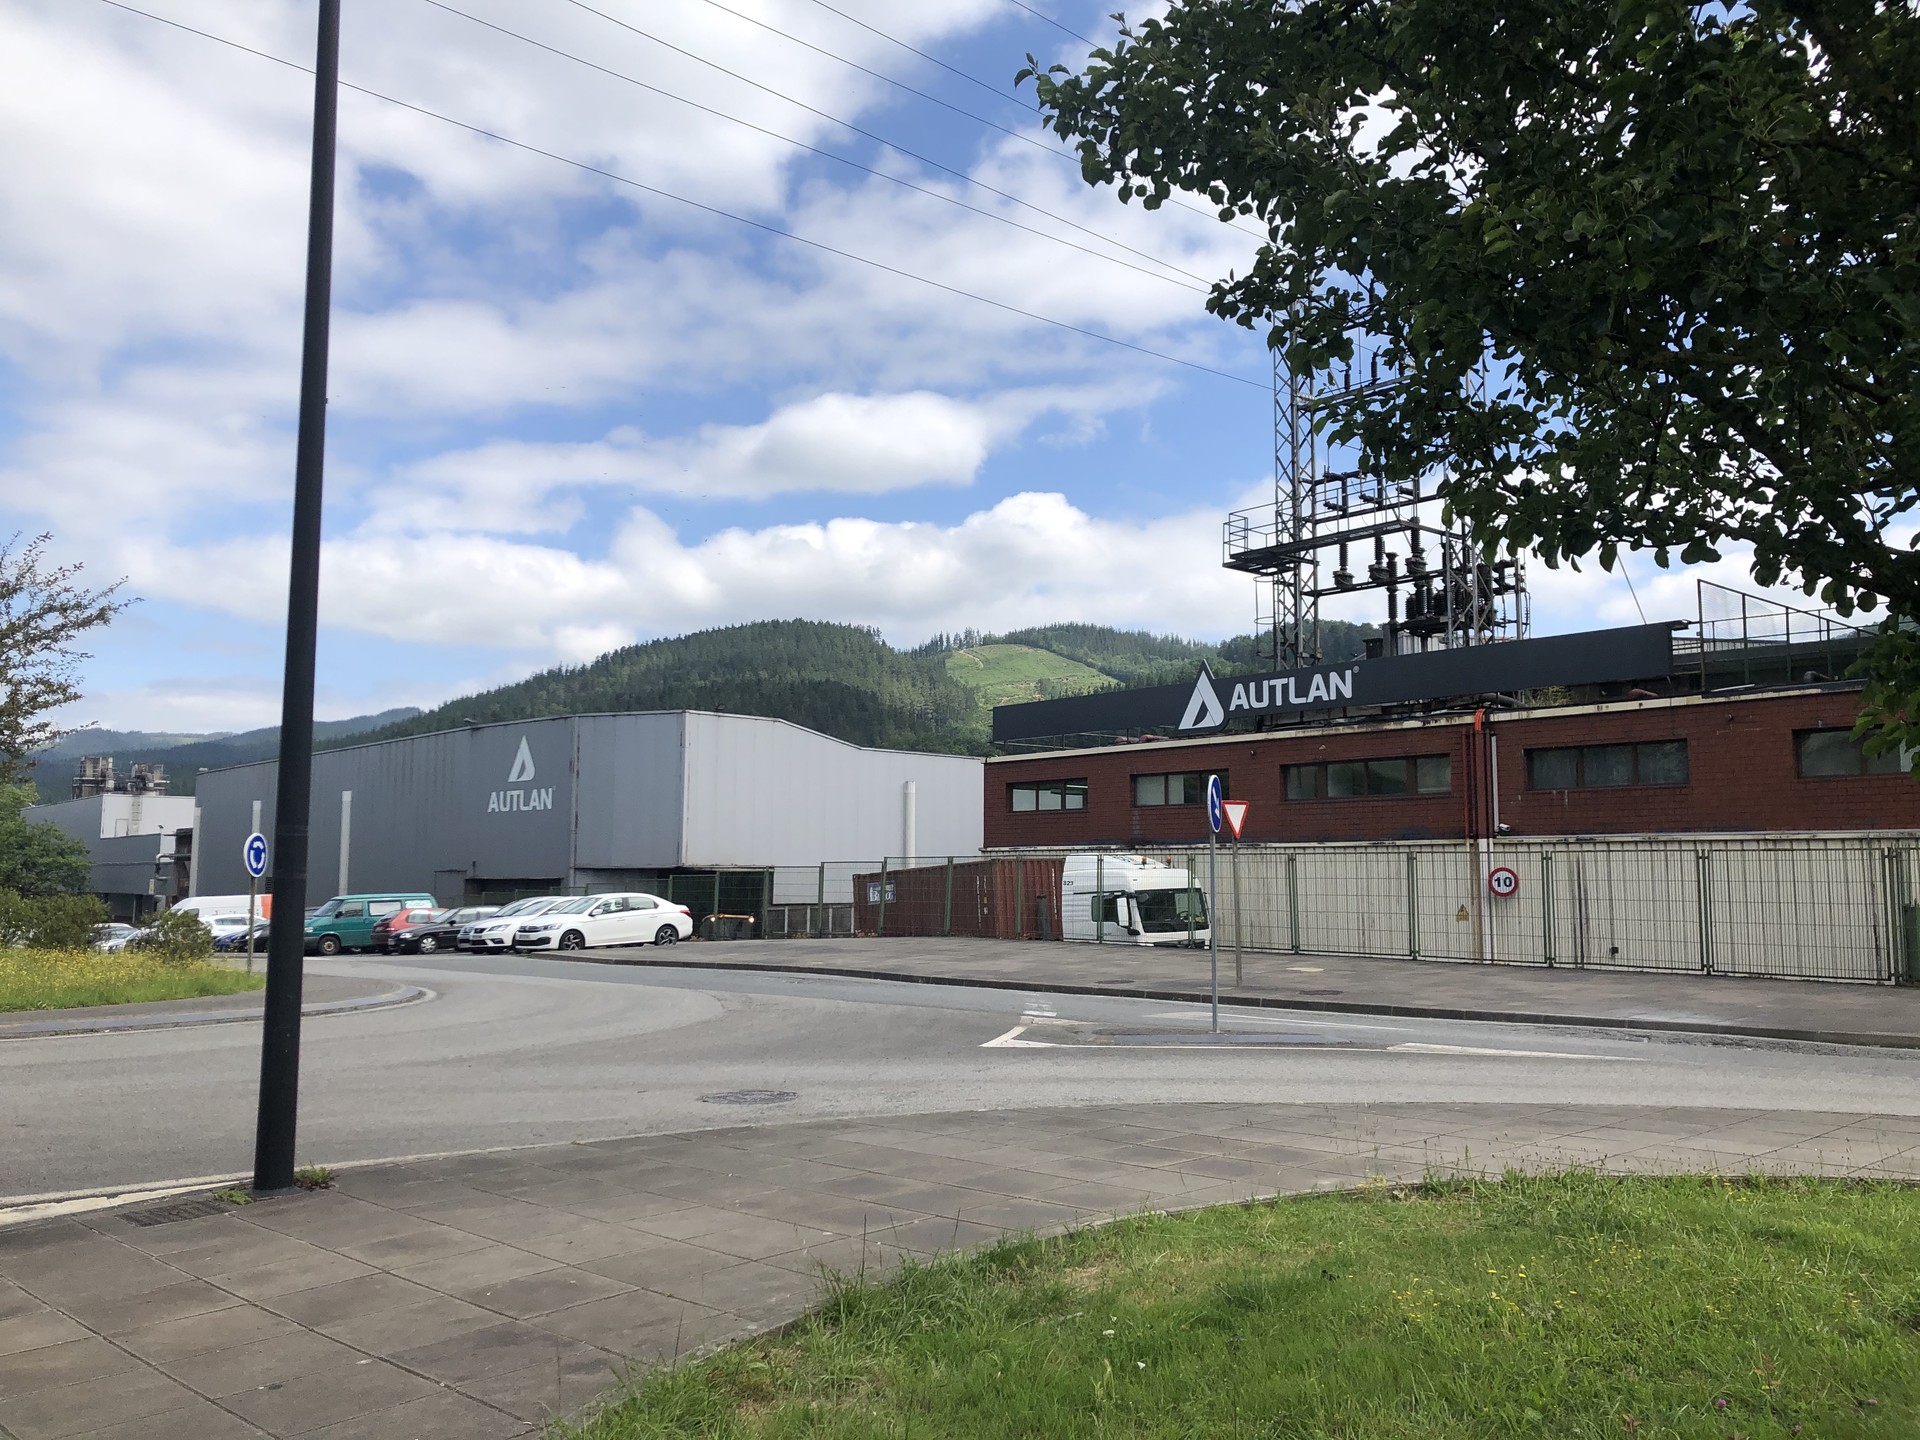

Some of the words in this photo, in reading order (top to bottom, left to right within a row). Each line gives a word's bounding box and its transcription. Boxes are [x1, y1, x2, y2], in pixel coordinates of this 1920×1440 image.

[1229, 669, 1352, 711] AUTLAN
[487, 788, 553, 812] AUTLAN
[1494, 876, 1513, 888] 10
